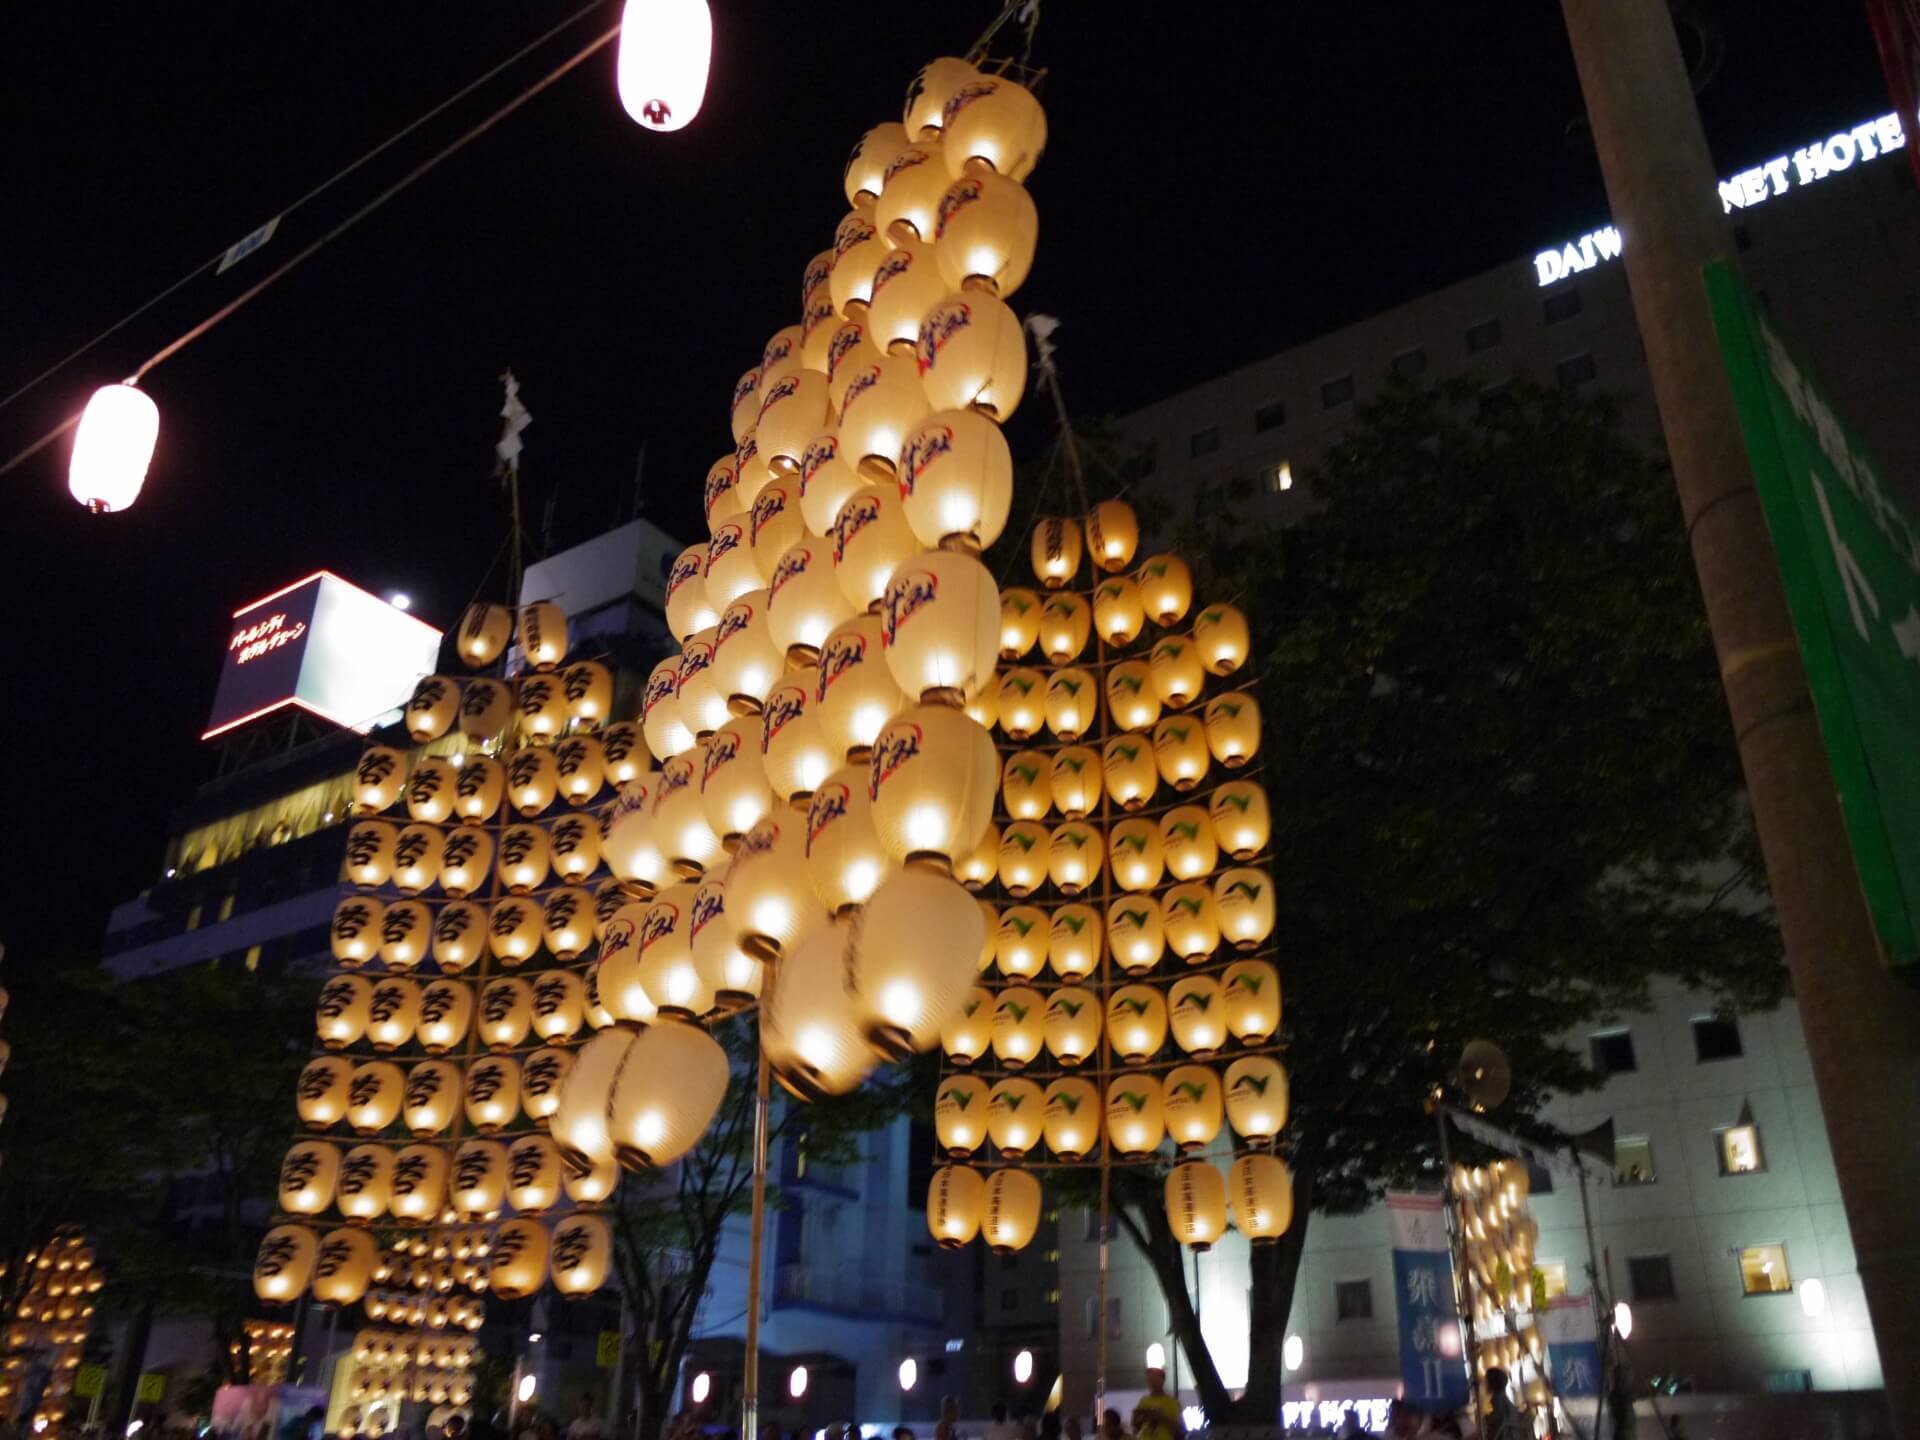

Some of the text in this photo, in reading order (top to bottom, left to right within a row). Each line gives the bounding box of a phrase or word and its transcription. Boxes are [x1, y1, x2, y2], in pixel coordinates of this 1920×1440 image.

[1534, 112, 1906, 287] DAIW NET HOTE
